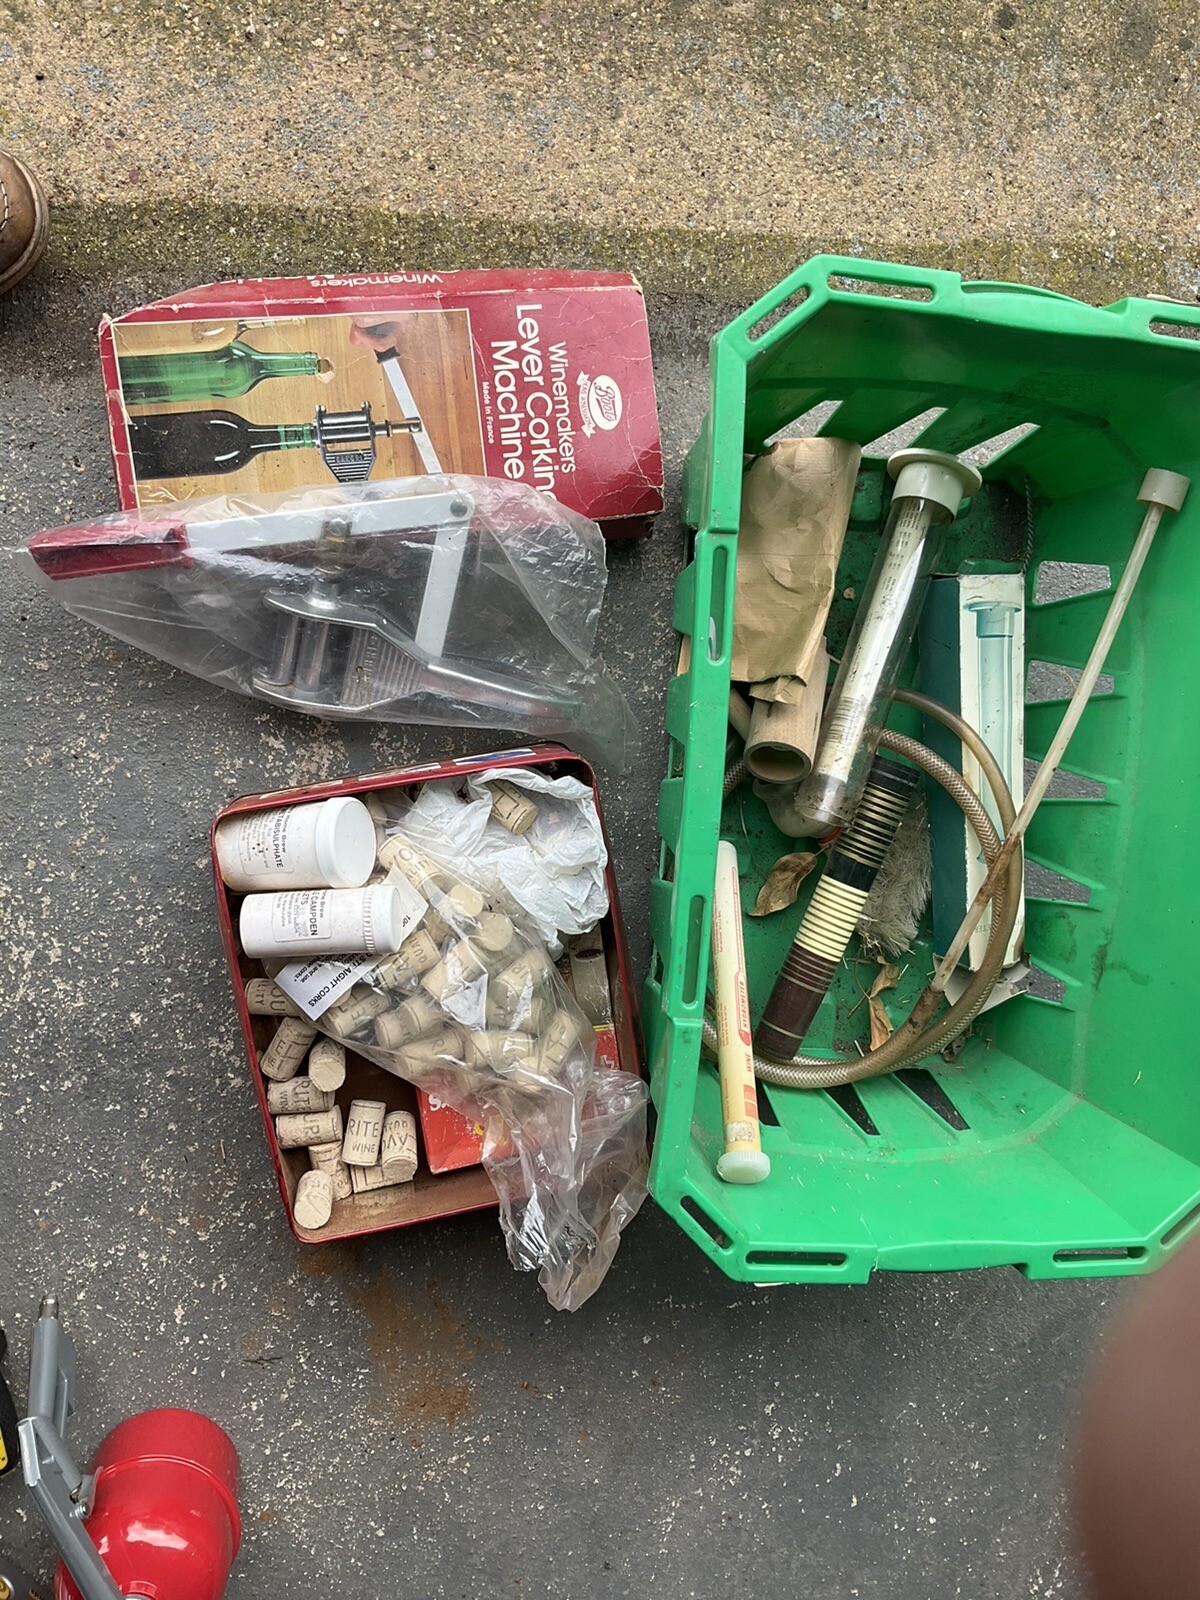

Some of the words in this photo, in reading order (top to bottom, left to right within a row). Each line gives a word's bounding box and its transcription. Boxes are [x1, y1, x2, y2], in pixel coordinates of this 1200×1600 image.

[311, 273, 443, 288] Winemakers
[516, 304, 544, 386] Lever
[482, 382, 490, 401] Made
[594, 382, 618, 422] Boots
[485, 403, 492, 414] in
[491, 340, 524, 479] Machine
[548, 341, 576, 473] Winemakers
[486, 415, 494, 444] France
[310, 896, 318, 936] CAMPDEN
[308, 986, 331, 1007] CORKS
[740, 981, 749, 1030] HYDROMETER
[349, 1120, 380, 1138] RITE
[352, 1143, 377, 1153] WINE
